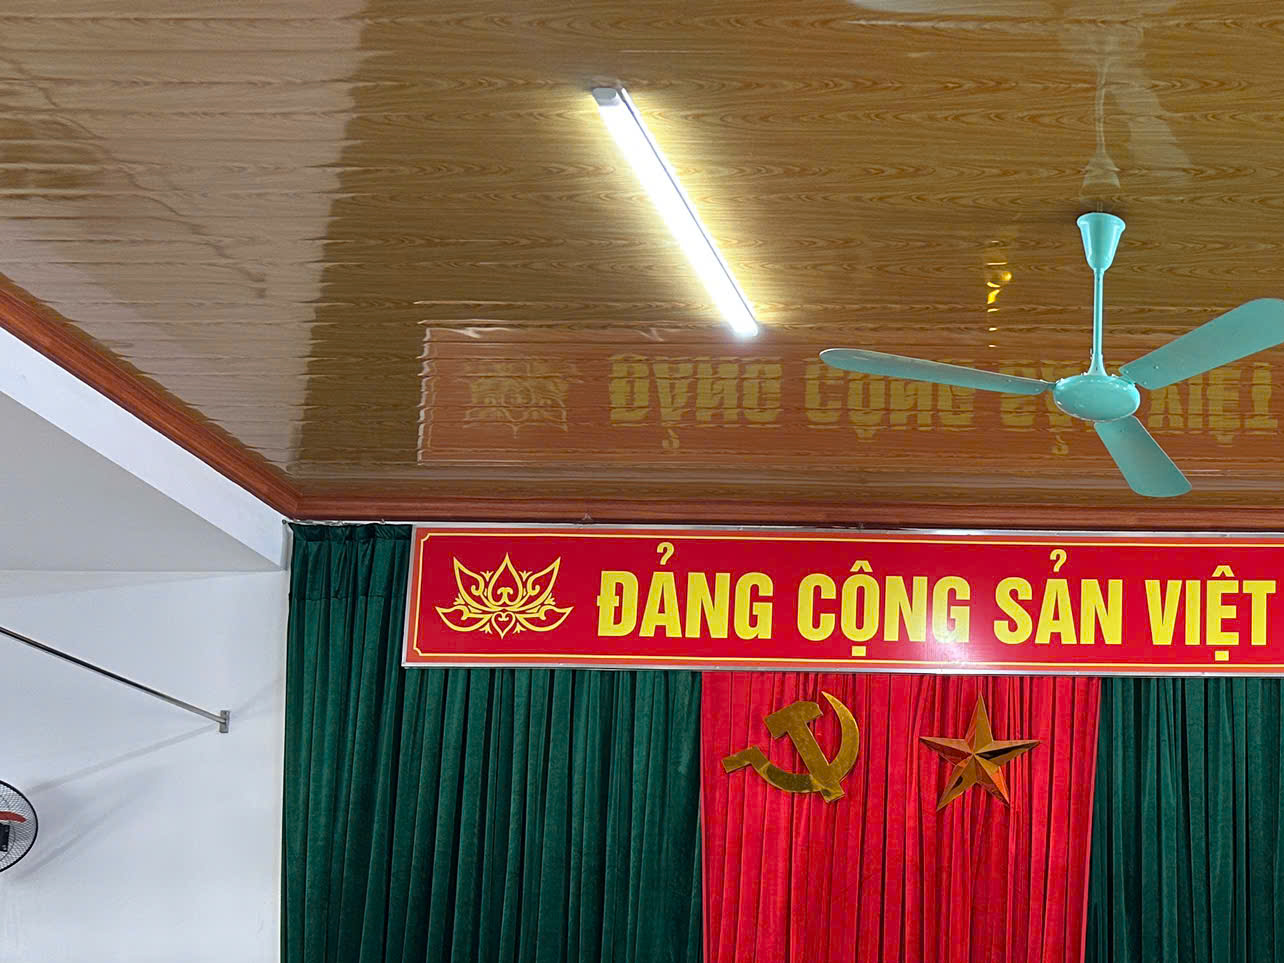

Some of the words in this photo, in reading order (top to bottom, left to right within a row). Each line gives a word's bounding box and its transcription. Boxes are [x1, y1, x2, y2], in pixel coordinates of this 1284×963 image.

[596, 543, 774, 640] ĐẢNG
[797, 560, 971, 657] CỘNG
[993, 549, 1123, 645] SẢN
[1144, 565, 1276, 661] VIỆT
